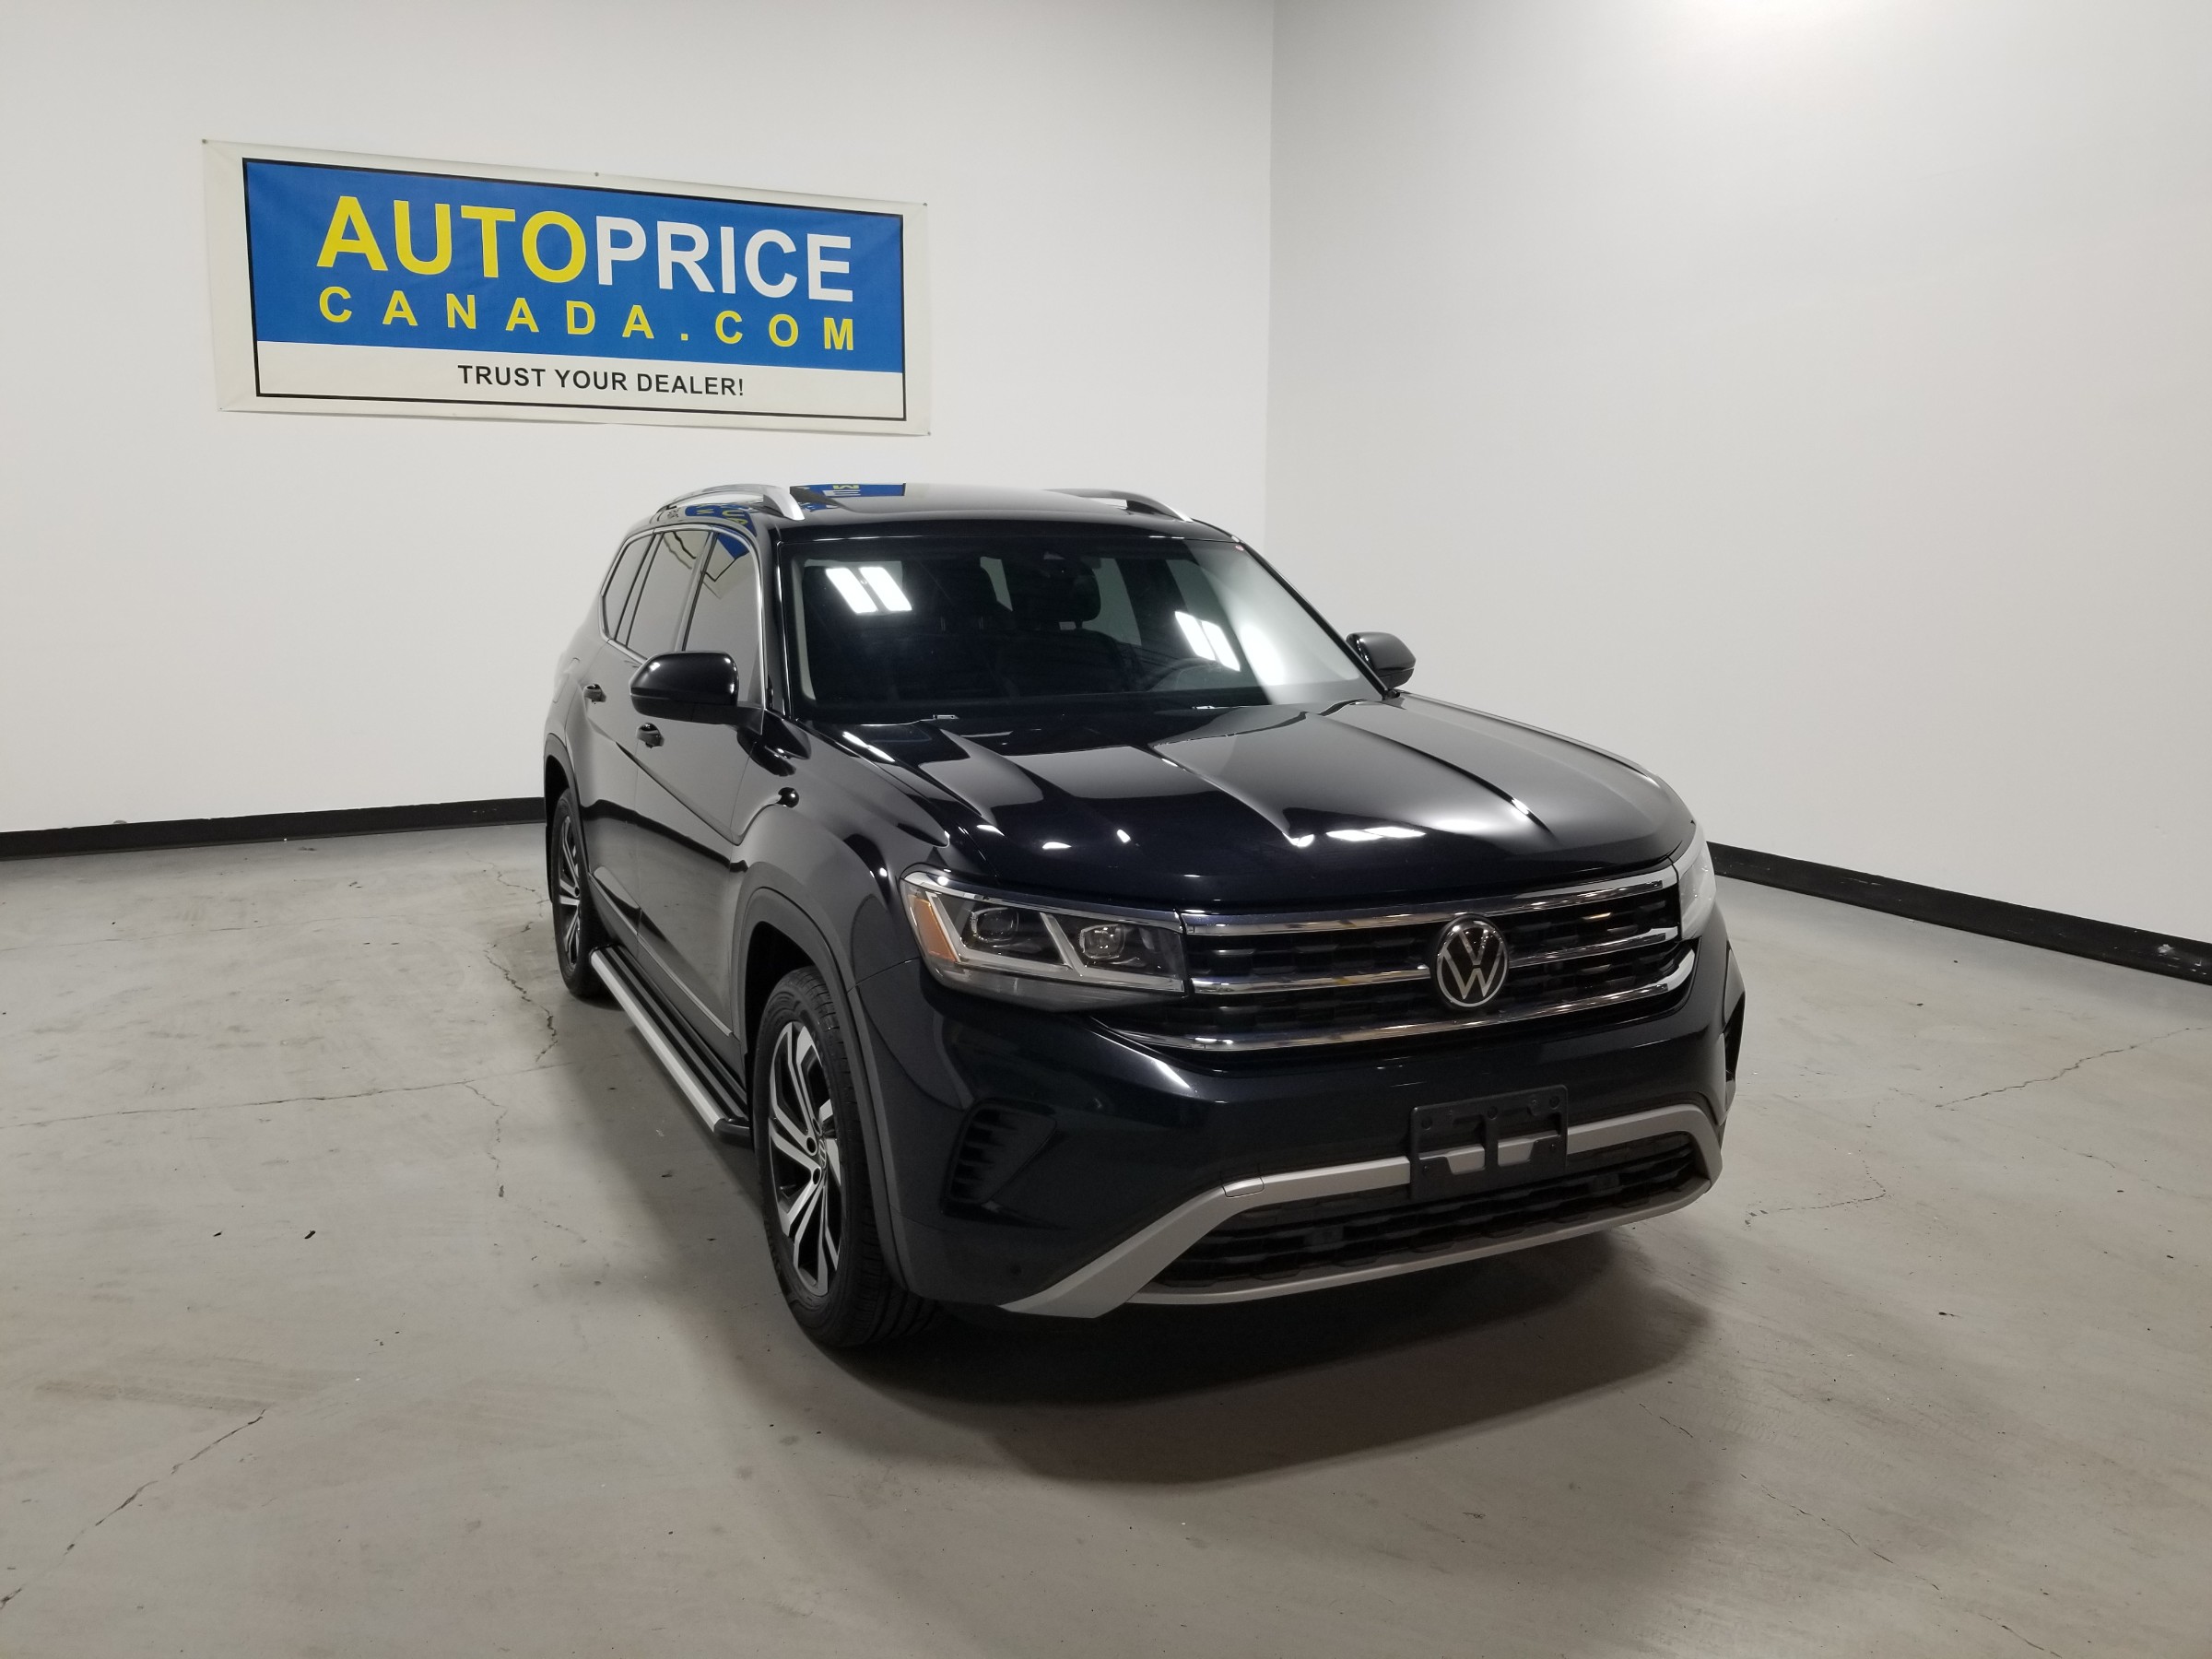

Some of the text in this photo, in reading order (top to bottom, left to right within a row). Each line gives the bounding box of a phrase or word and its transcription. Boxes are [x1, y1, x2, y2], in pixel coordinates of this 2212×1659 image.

[316, 195, 853, 302] AUTOPRICE
[319, 286, 854, 351] CANADA.COM
[457, 364, 744, 396] TRUST YOUR DEALER!
